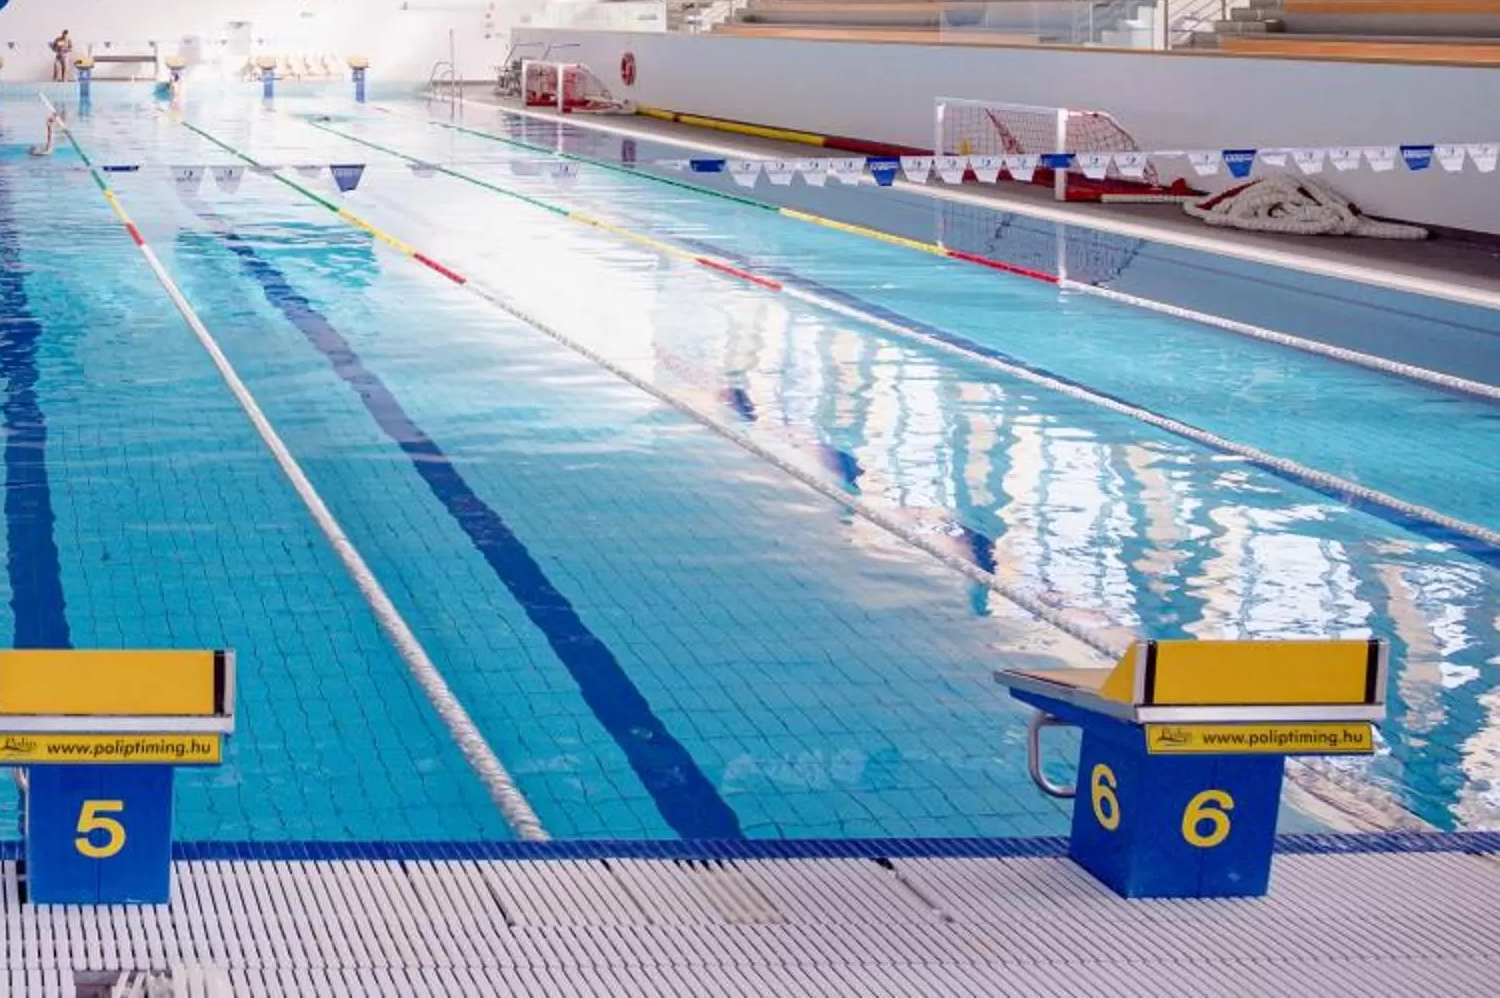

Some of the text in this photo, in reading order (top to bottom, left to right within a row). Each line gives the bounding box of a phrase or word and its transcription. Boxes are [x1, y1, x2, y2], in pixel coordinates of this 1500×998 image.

[47, 739, 211, 757] www.poliptiming.hu
[1203, 730, 1363, 746] www.poliptiming.hu
[1091, 763, 1120, 831] 6
[1181, 788, 1235, 848] 6
[75, 799, 126, 859] 5
